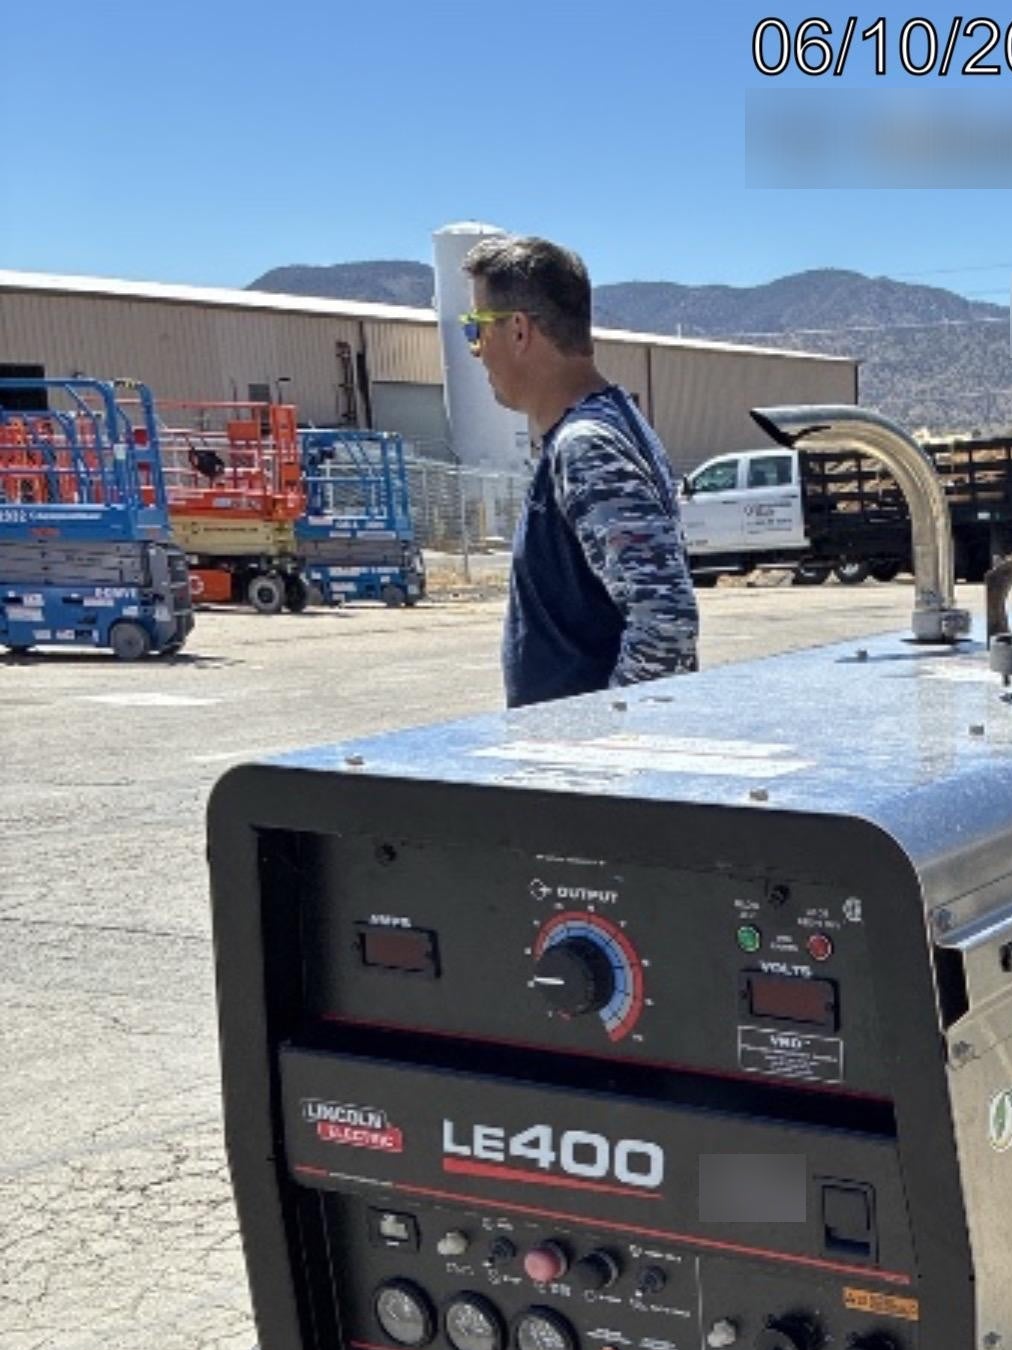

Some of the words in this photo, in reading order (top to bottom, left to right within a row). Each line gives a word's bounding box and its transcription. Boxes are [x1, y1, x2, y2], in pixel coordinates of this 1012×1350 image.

[307, 1103, 384, 1129] LINCOLN
[326, 1125, 395, 1148] ELECTRIC
[443, 1117, 665, 1189] LE400
